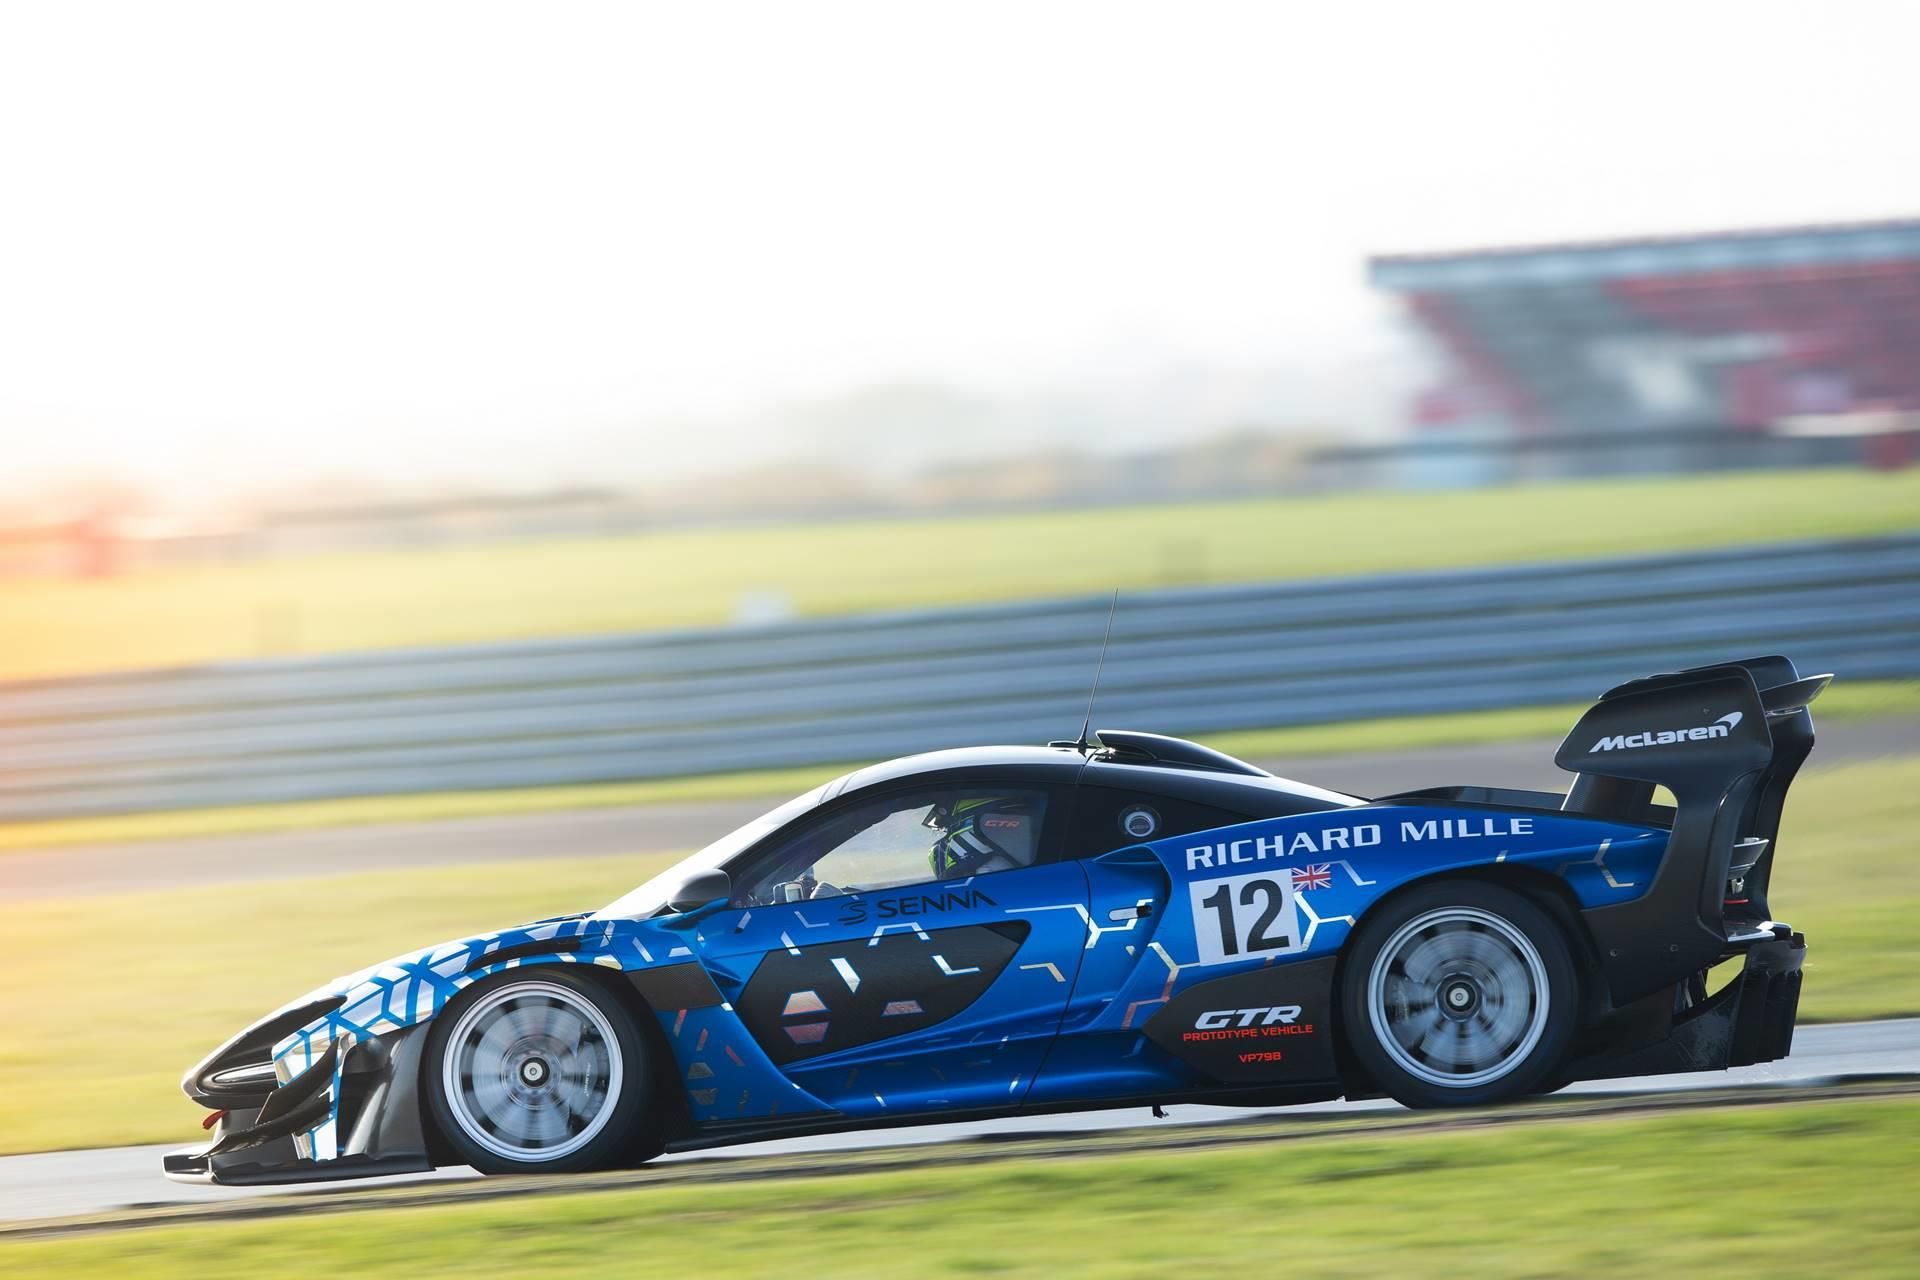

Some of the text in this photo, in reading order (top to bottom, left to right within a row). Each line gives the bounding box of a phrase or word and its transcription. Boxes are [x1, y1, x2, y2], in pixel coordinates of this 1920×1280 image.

[1588, 725, 1729, 753] McLaren
[984, 819, 1020, 828] GTR
[1186, 818, 1534, 871] RICHARD MILLE
[877, 890, 998, 918] SENNA
[1202, 879, 1290, 956] 12
[1194, 1005, 1302, 1030] GTR
[1183, 1024, 1313, 1042] PROTOTYPE VEHICLE
